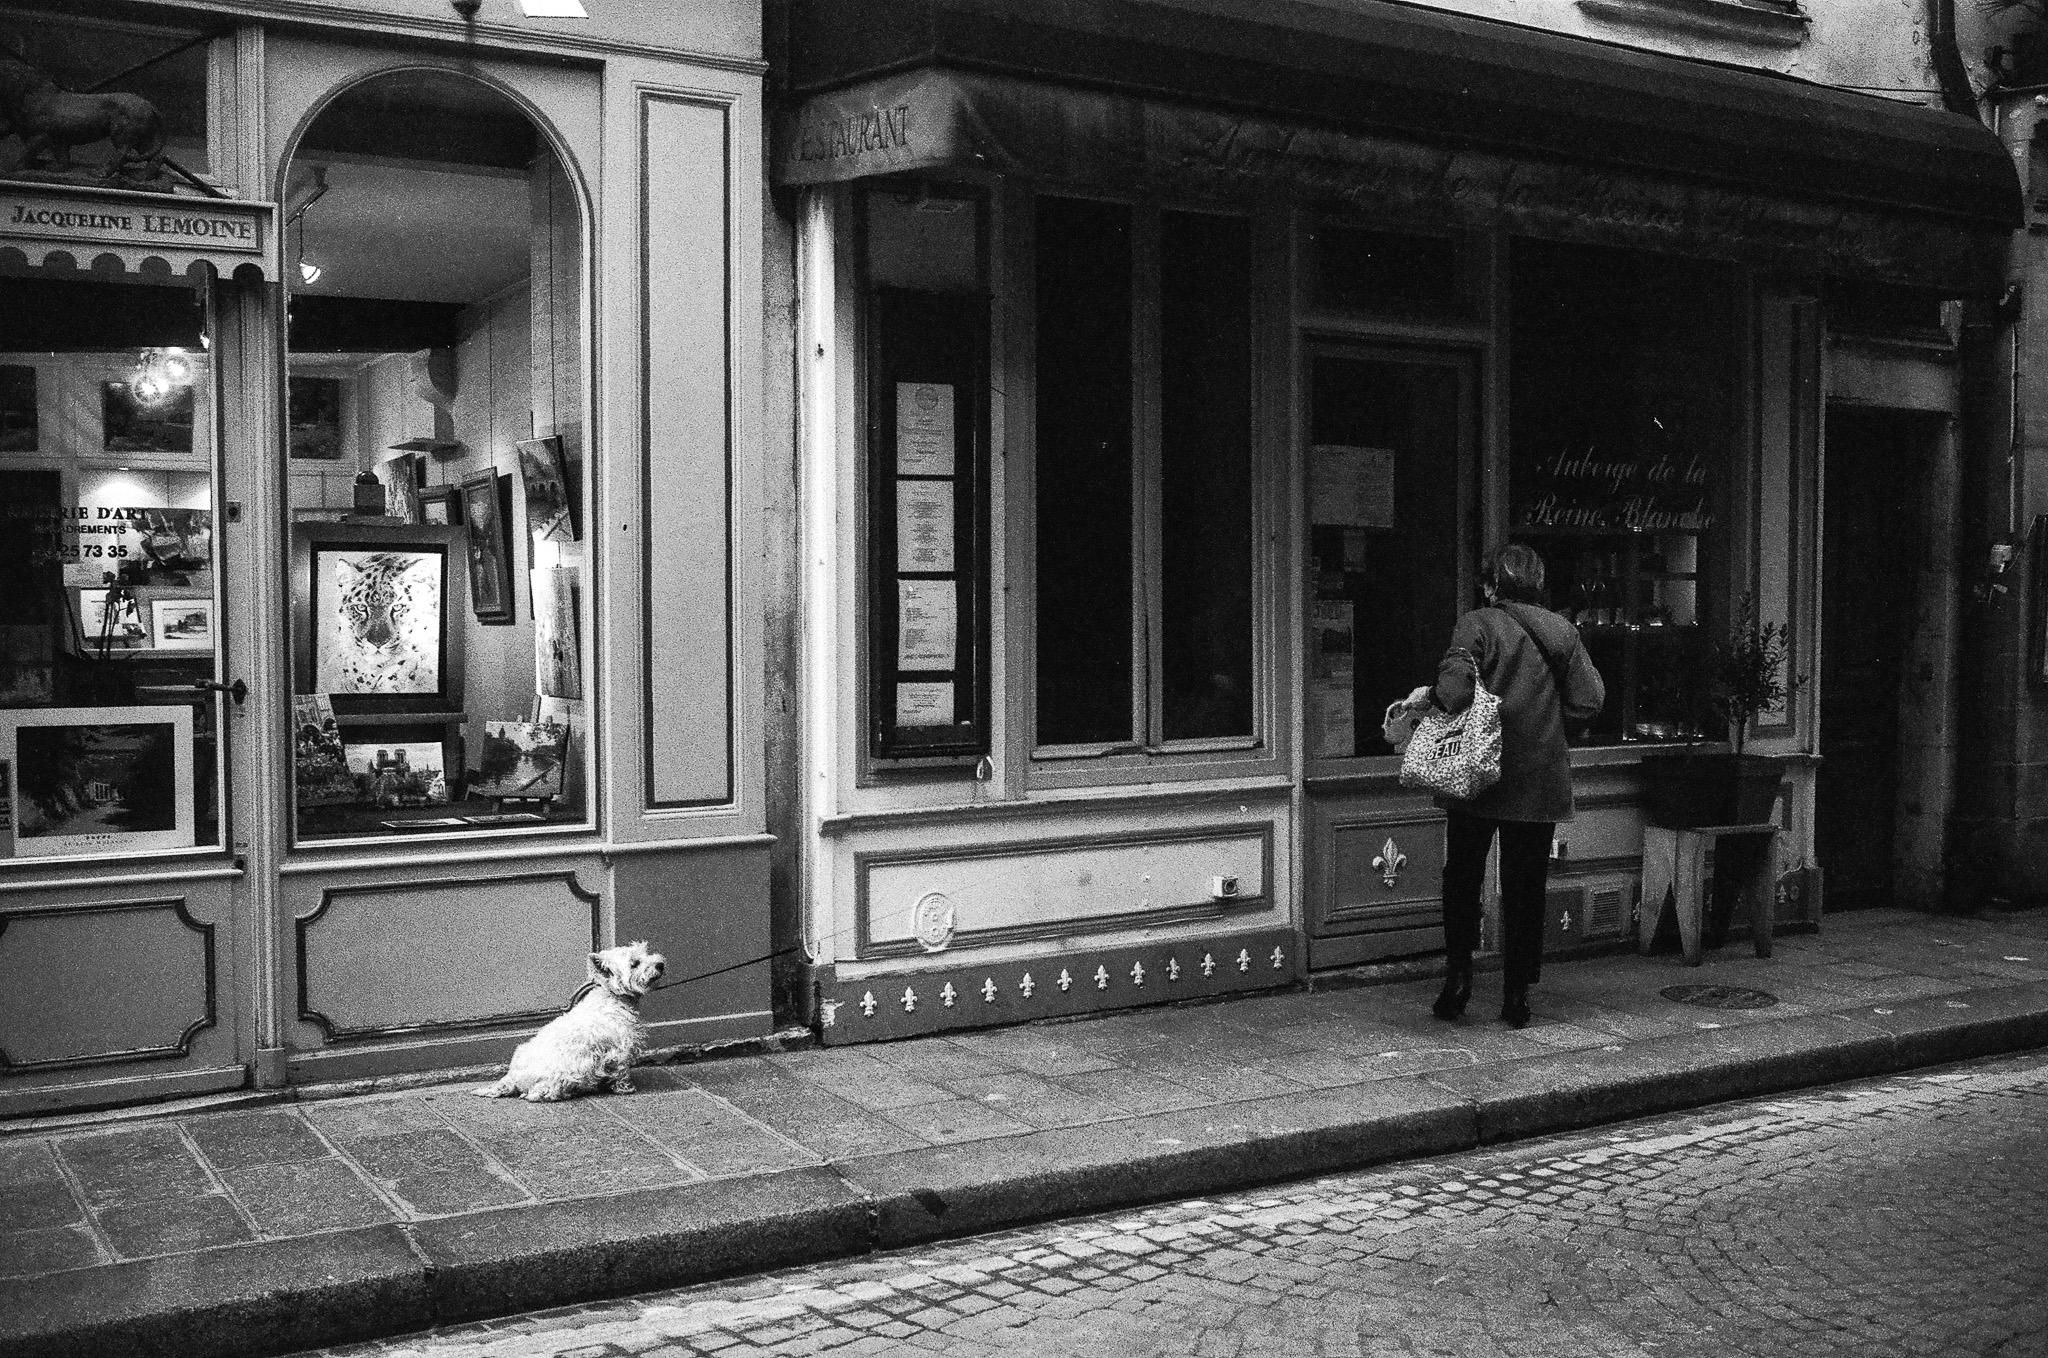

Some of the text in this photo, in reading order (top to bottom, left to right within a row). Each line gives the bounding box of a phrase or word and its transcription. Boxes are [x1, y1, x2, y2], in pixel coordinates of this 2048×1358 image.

[142, 214, 252, 239] LEMOINE
[1648, 454, 1677, 482] de
[1685, 453, 1708, 485] la
[82, 545, 103, 558] 73
[107, 545, 129, 558] 35
